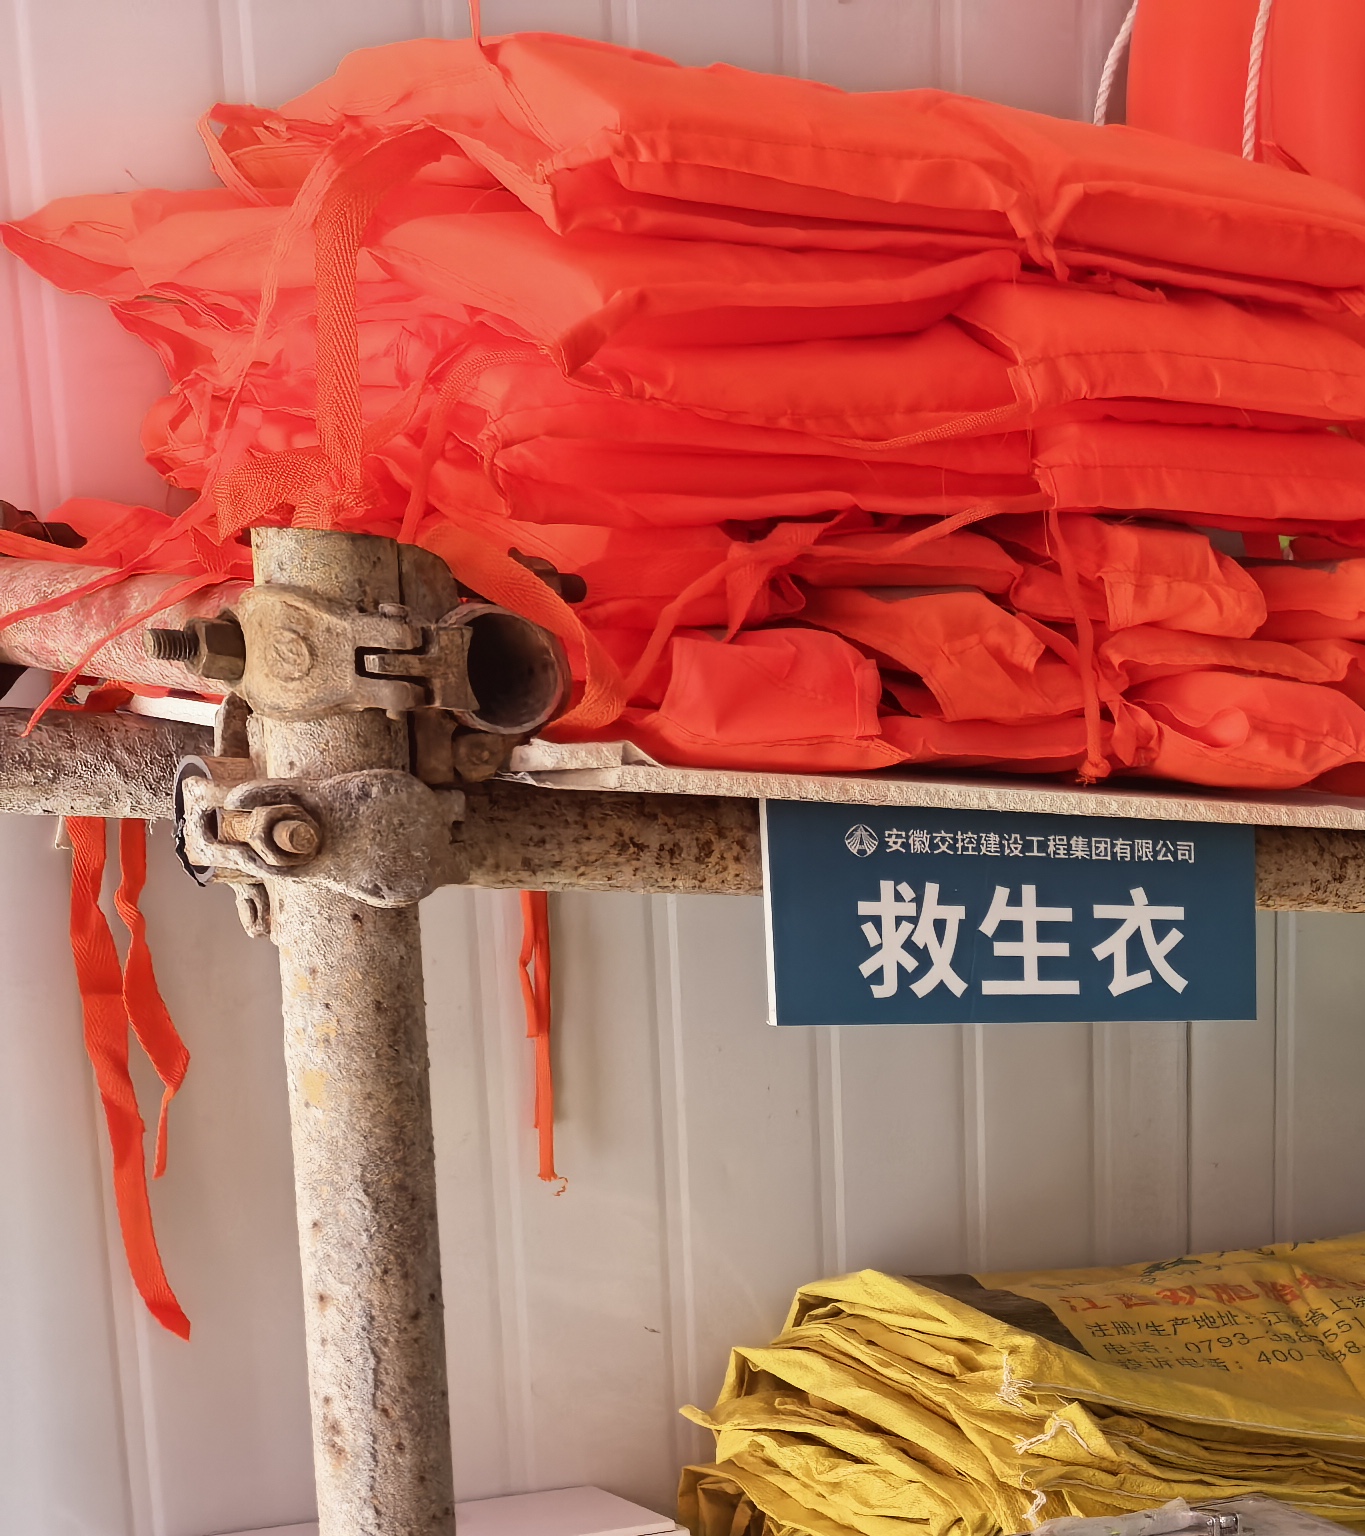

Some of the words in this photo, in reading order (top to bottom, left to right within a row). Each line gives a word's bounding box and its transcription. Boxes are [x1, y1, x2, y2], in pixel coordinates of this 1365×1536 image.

[883, 828, 1196, 864] 安徽交控建设工程集团有限公司
[857, 880, 1189, 999] 救生衣
